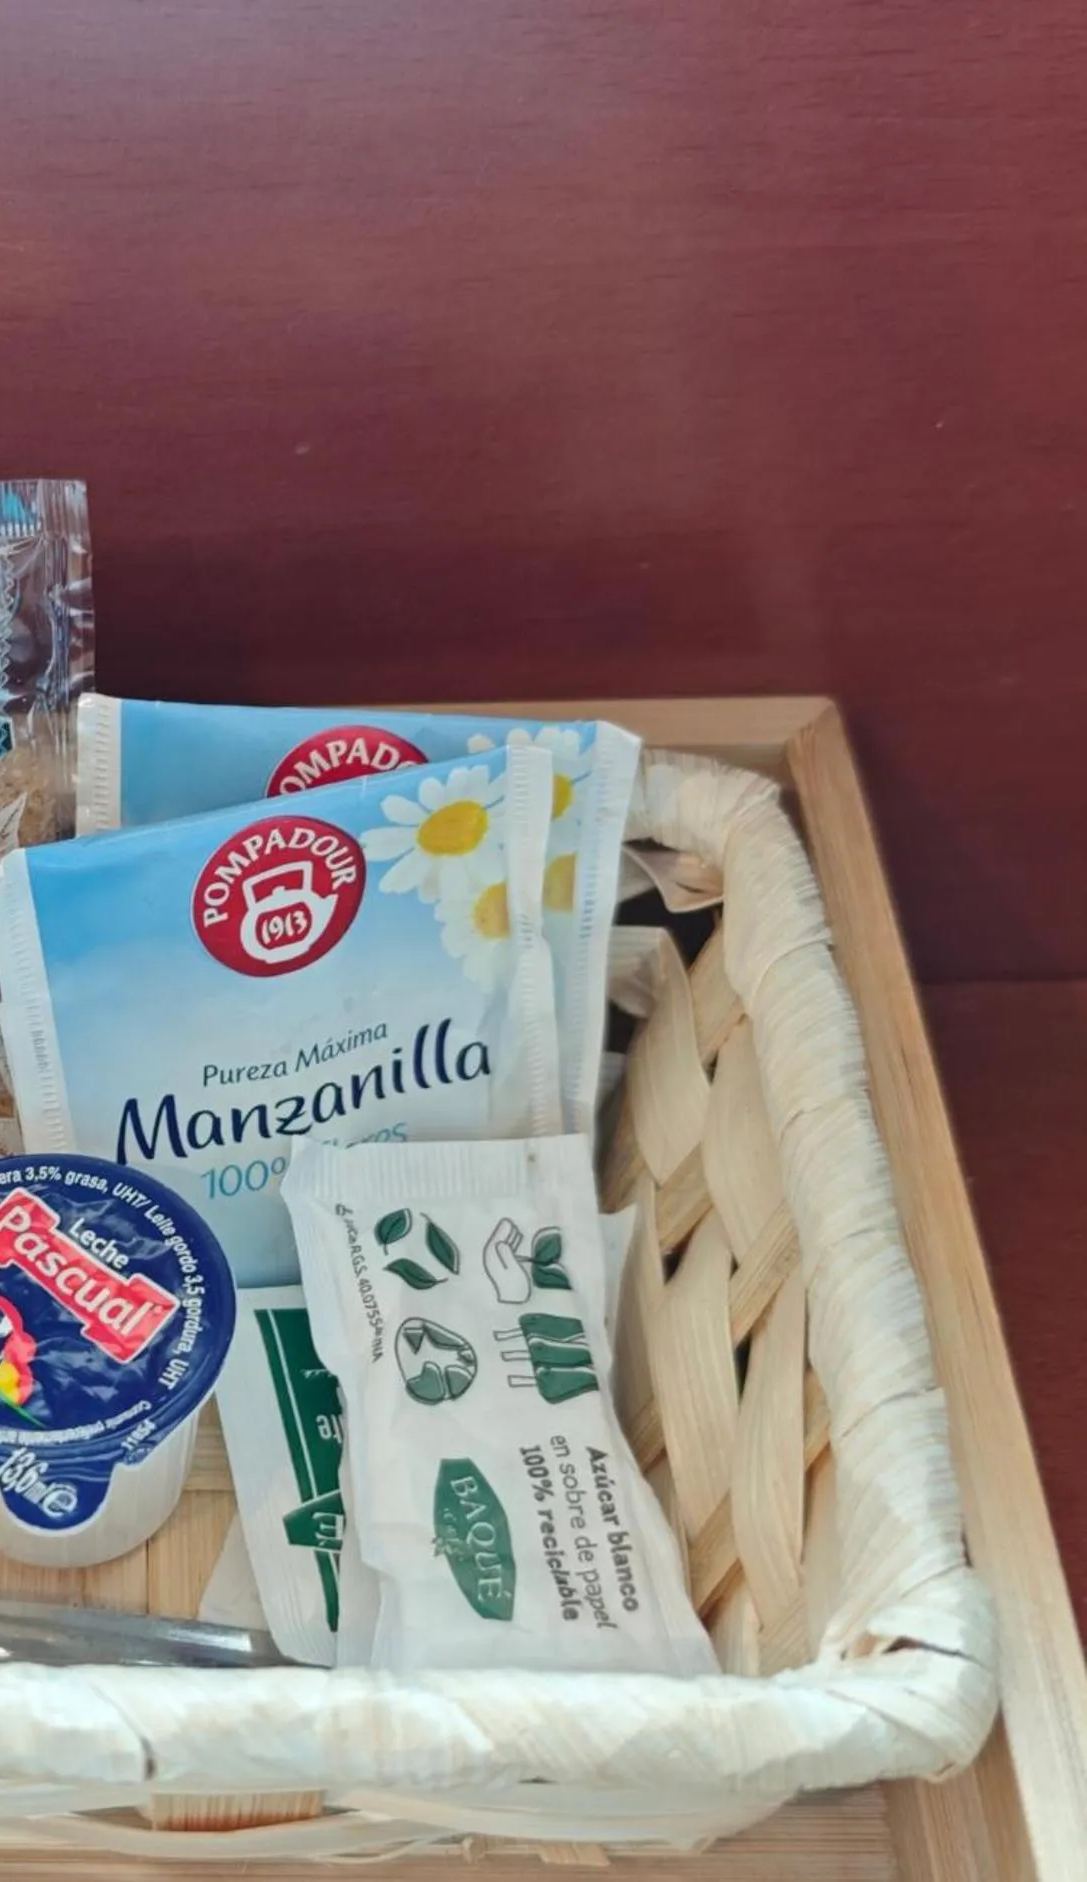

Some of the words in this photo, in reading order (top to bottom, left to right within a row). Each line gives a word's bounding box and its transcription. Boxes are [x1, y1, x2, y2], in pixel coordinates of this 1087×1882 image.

[202, 826, 360, 928] POMPADOUR
[260, 905, 308, 945] 1913
[202, 1060, 289, 1088] Pureza
[294, 1021, 389, 1073] Máxima
[115, 1018, 493, 1166] Manzanilla
[24, 1165, 63, 1183] 3,5%
[64, 1169, 110, 1195] grasa,
[69, 1216, 130, 1269] Leche
[165, 1231, 199, 1274] gordo
[158, 1357, 191, 1392] UHT
[519, 1444, 556, 1503] 100%
[550, 1434, 571, 1458] en
[558, 1462, 588, 1530] sobre
[449, 1475, 513, 1602] BAQUÉ
[574, 1534, 598, 1563] de
[585, 1445, 620, 1527] Azúcar
[607, 1530, 640, 1613] blanco
[537, 1508, 583, 1622] reciclable
[574, 1567, 619, 1630] papel
